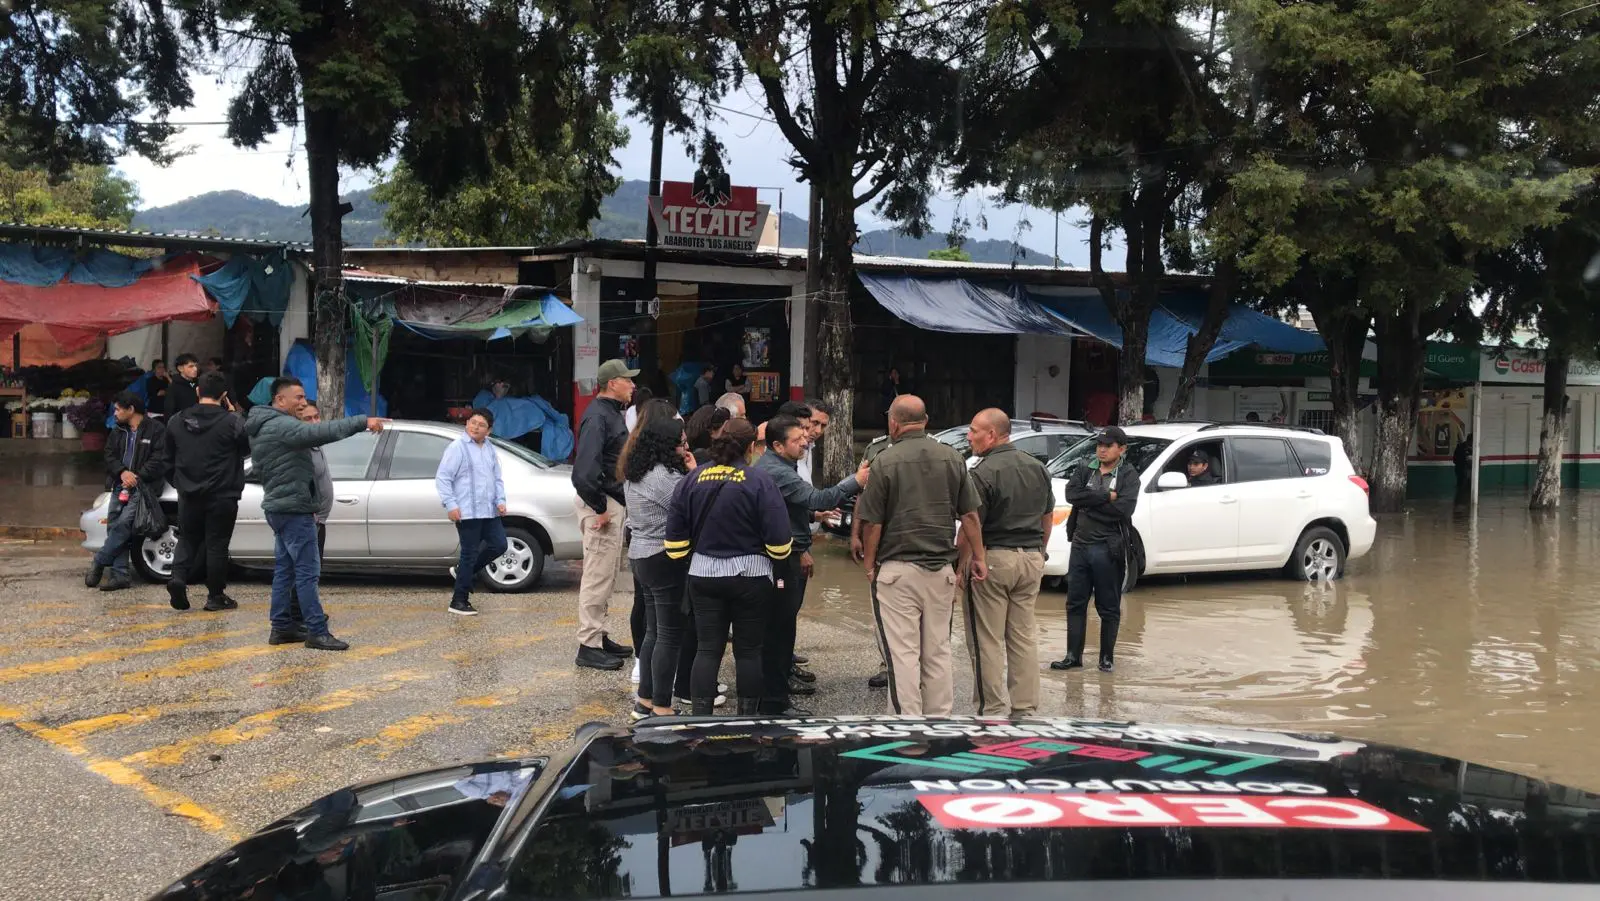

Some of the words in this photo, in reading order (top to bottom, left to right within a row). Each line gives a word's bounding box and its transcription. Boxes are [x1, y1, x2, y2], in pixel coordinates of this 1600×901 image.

[663, 205, 757, 237] TECATE
[663, 235, 705, 249] ABARROTES
[1428, 354, 1436, 363] El
[1511, 358, 1546, 373] Castr
[1567, 364, 1583, 375] uto
[910, 778, 1327, 795] CORRUPCION
